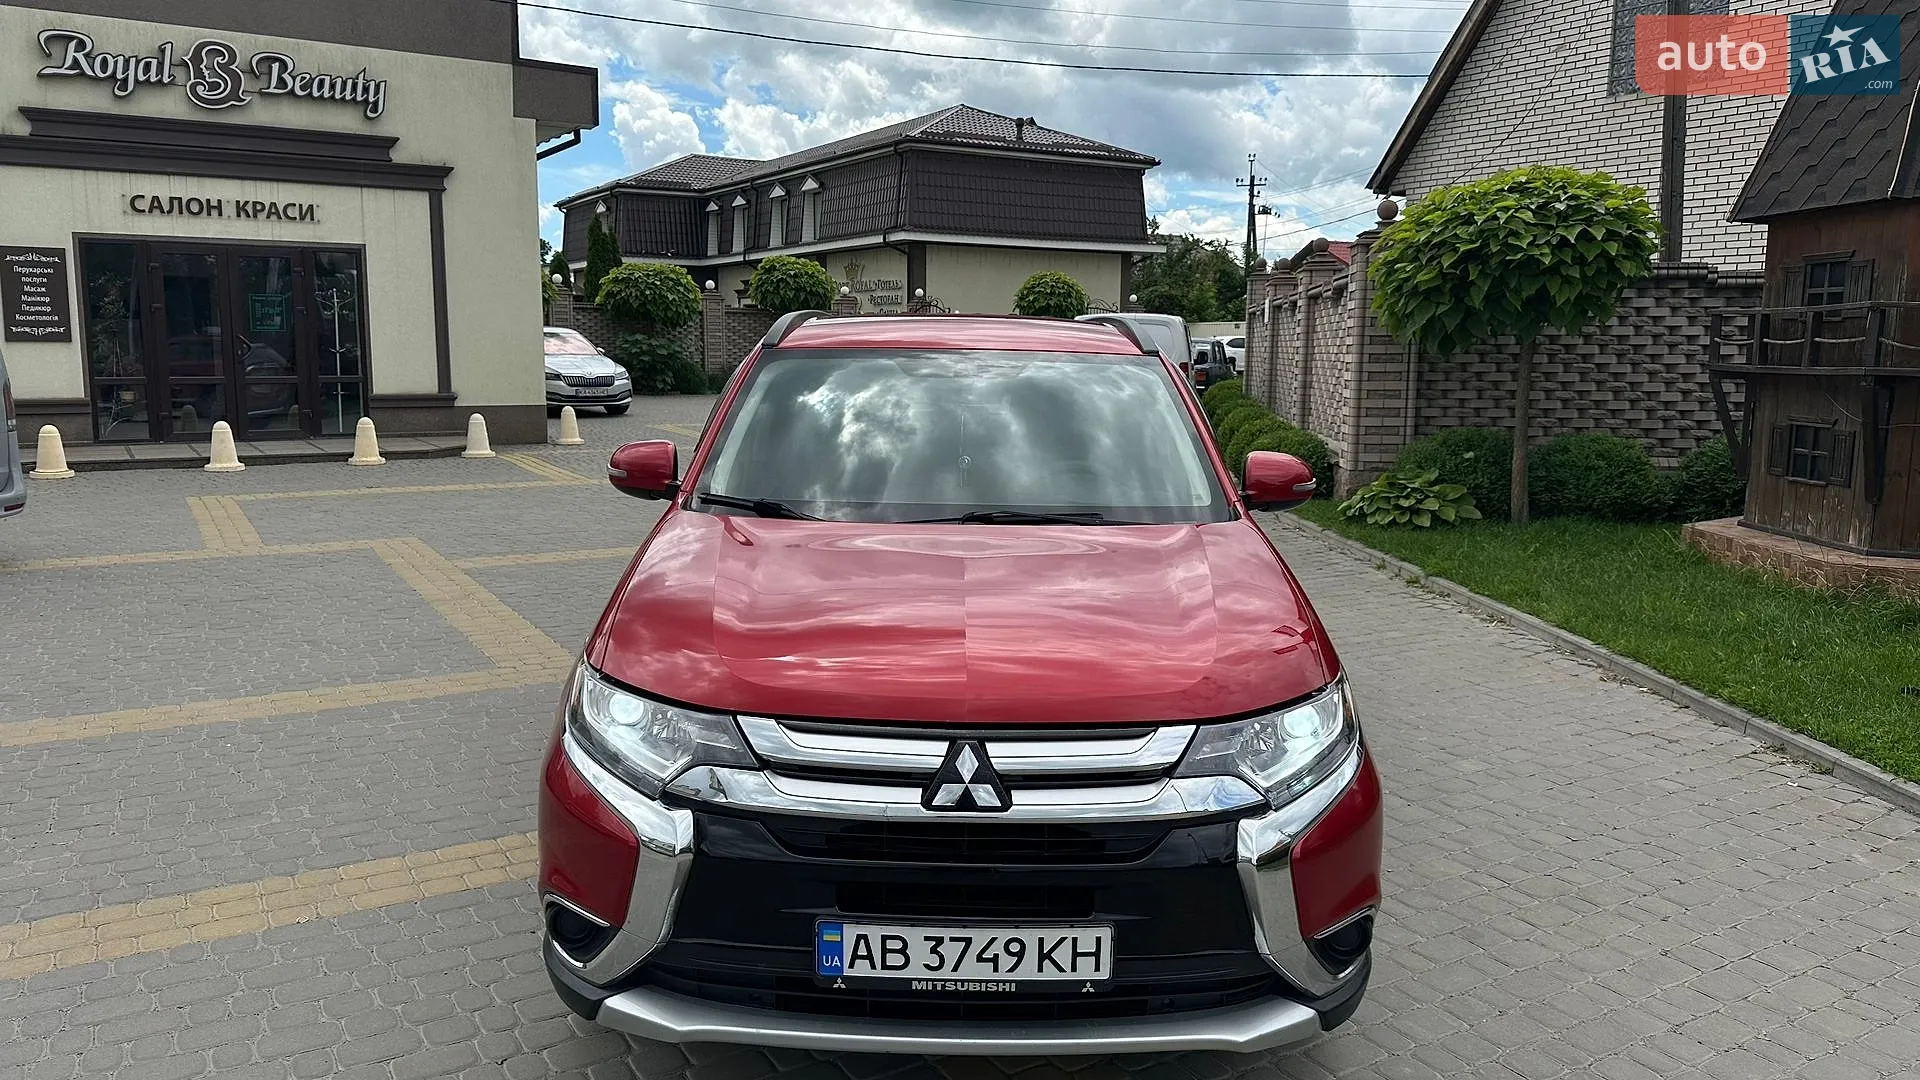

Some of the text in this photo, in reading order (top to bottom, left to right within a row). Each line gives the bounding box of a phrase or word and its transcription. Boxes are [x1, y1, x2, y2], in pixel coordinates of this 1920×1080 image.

[37, 29, 387, 119] Royal Beauty
[129, 194, 316, 222] САЛОН КРАСИ
[13, 265, 54, 274] Перукарські
[21, 276, 48, 284] послуги
[21, 294, 50, 303] Манікюр
[21, 304, 52, 312] Педикюр
[15, 313, 59, 321] Косметологія
[848, 933, 1102, 973] AB 3749 KH
[823, 955, 841, 967] UA
[911, 980, 1016, 992] MITSUBISHI
